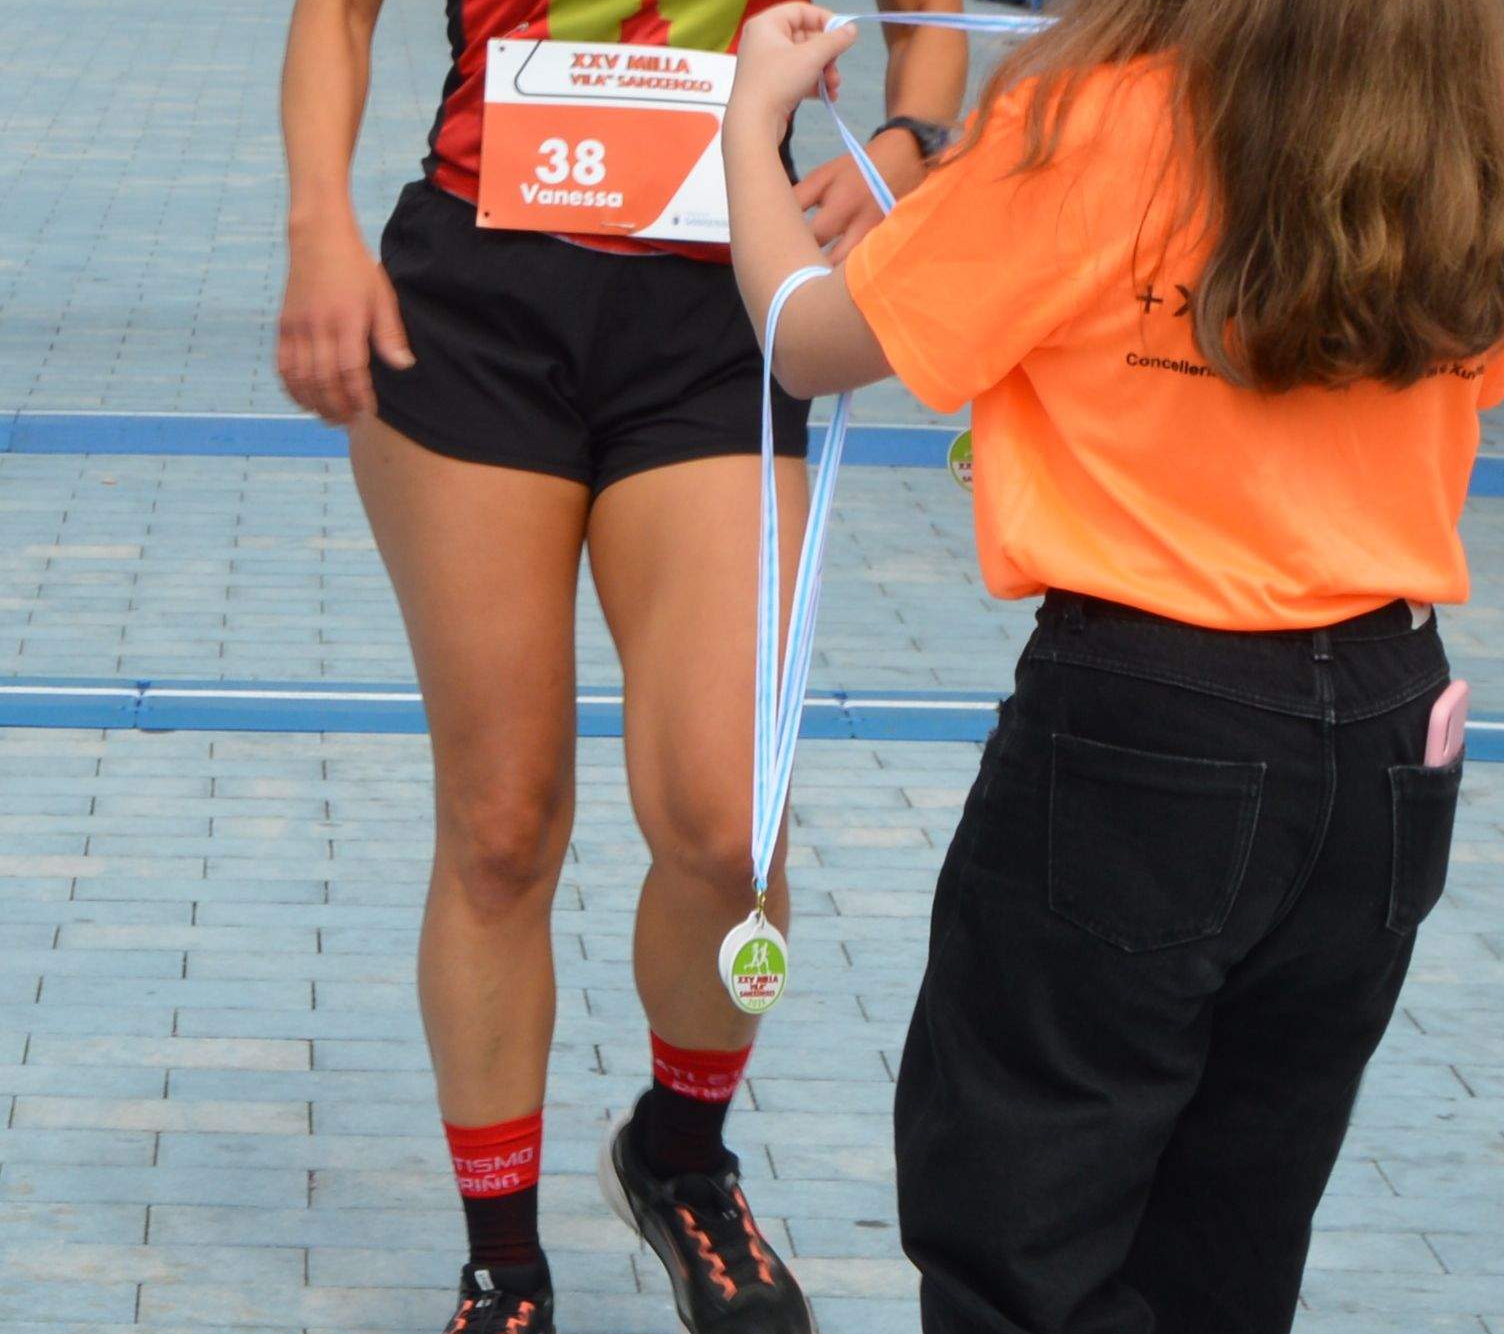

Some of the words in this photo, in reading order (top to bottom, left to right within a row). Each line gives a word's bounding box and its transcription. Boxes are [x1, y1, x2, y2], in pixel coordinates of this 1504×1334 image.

[570, 53, 620, 69] XXV
[626, 55, 690, 75] MILLA
[534, 137, 607, 186] 38
[519, 182, 624, 208] Vanessa
[453, 1146, 533, 1174] TISMO
